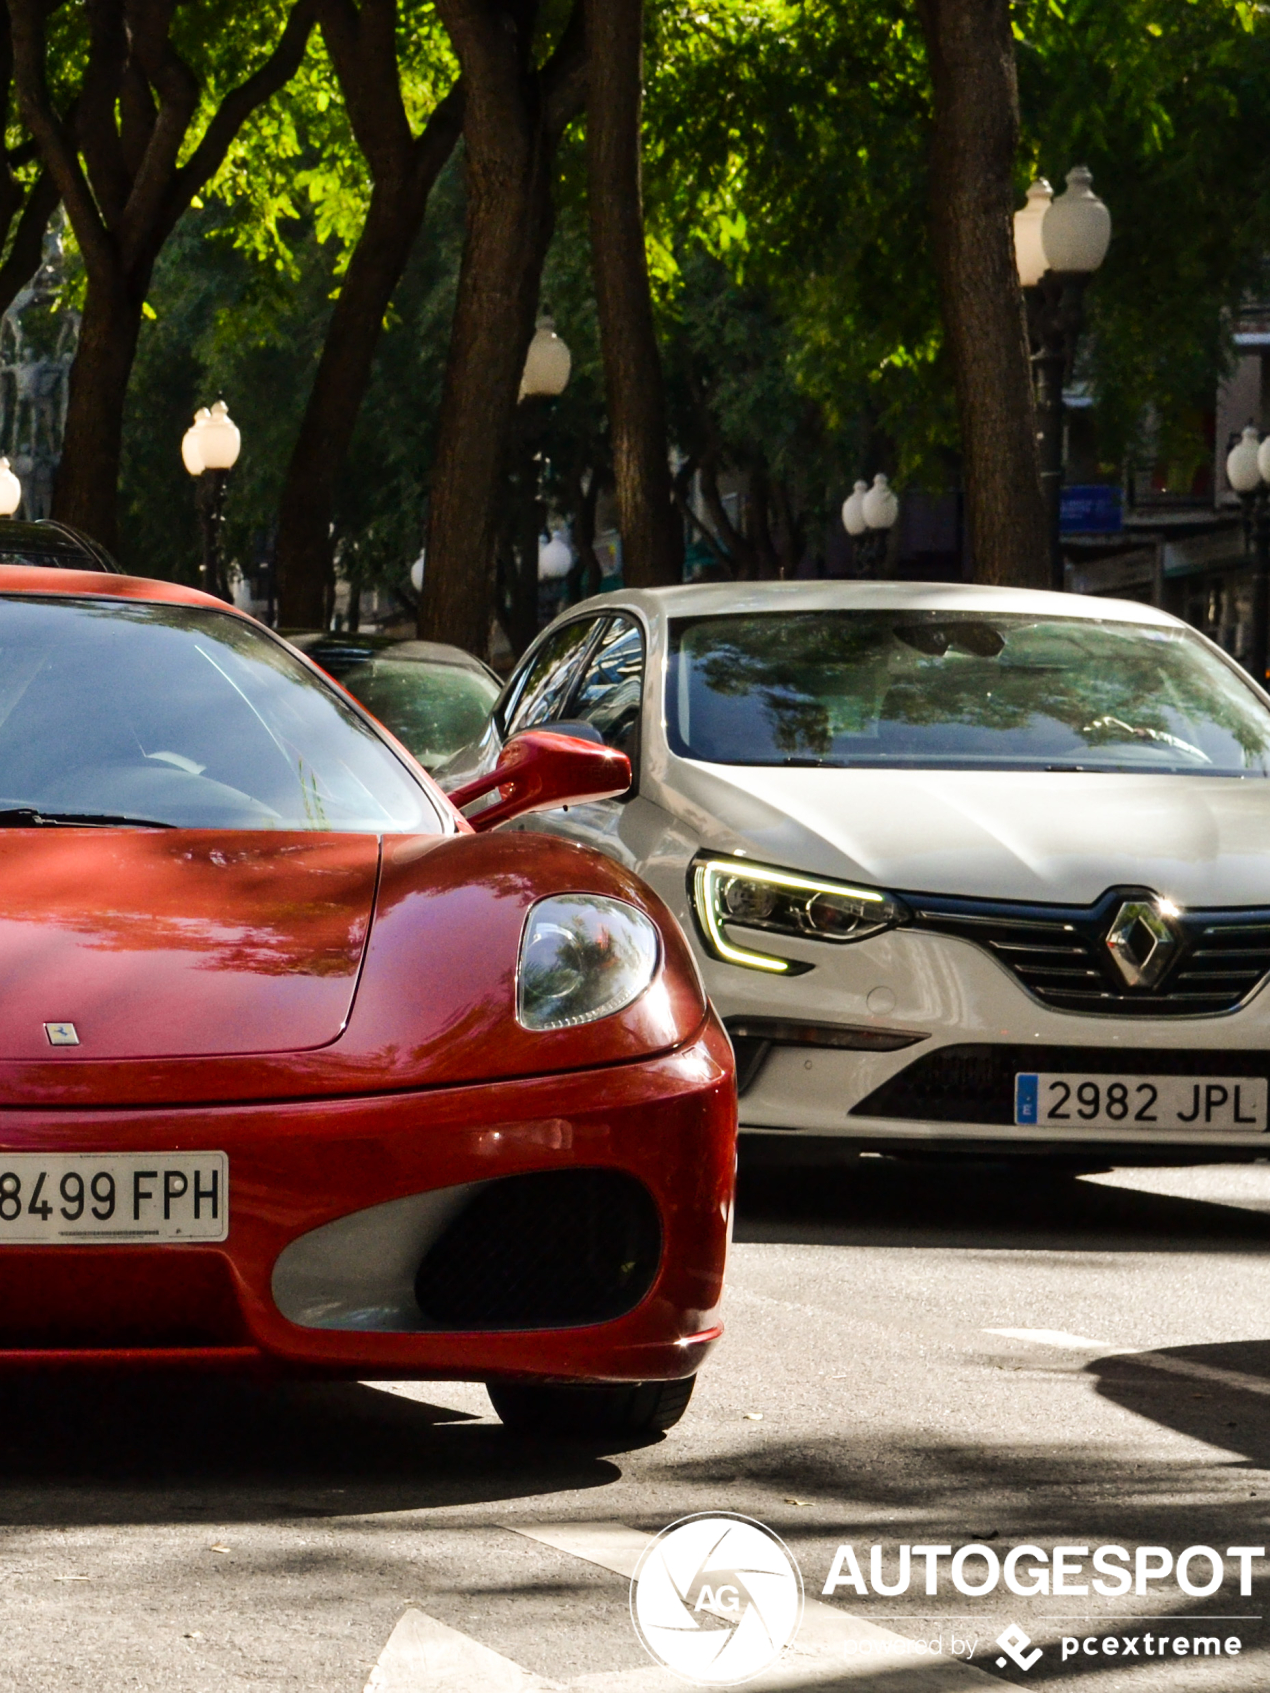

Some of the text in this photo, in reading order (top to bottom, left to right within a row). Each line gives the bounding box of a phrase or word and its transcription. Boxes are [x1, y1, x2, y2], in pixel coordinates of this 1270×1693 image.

[1022, 1104, 1032, 1115] E
[1047, 1081, 1257, 1123] 2982 JPL
[133, 1170, 218, 1220] FPH
